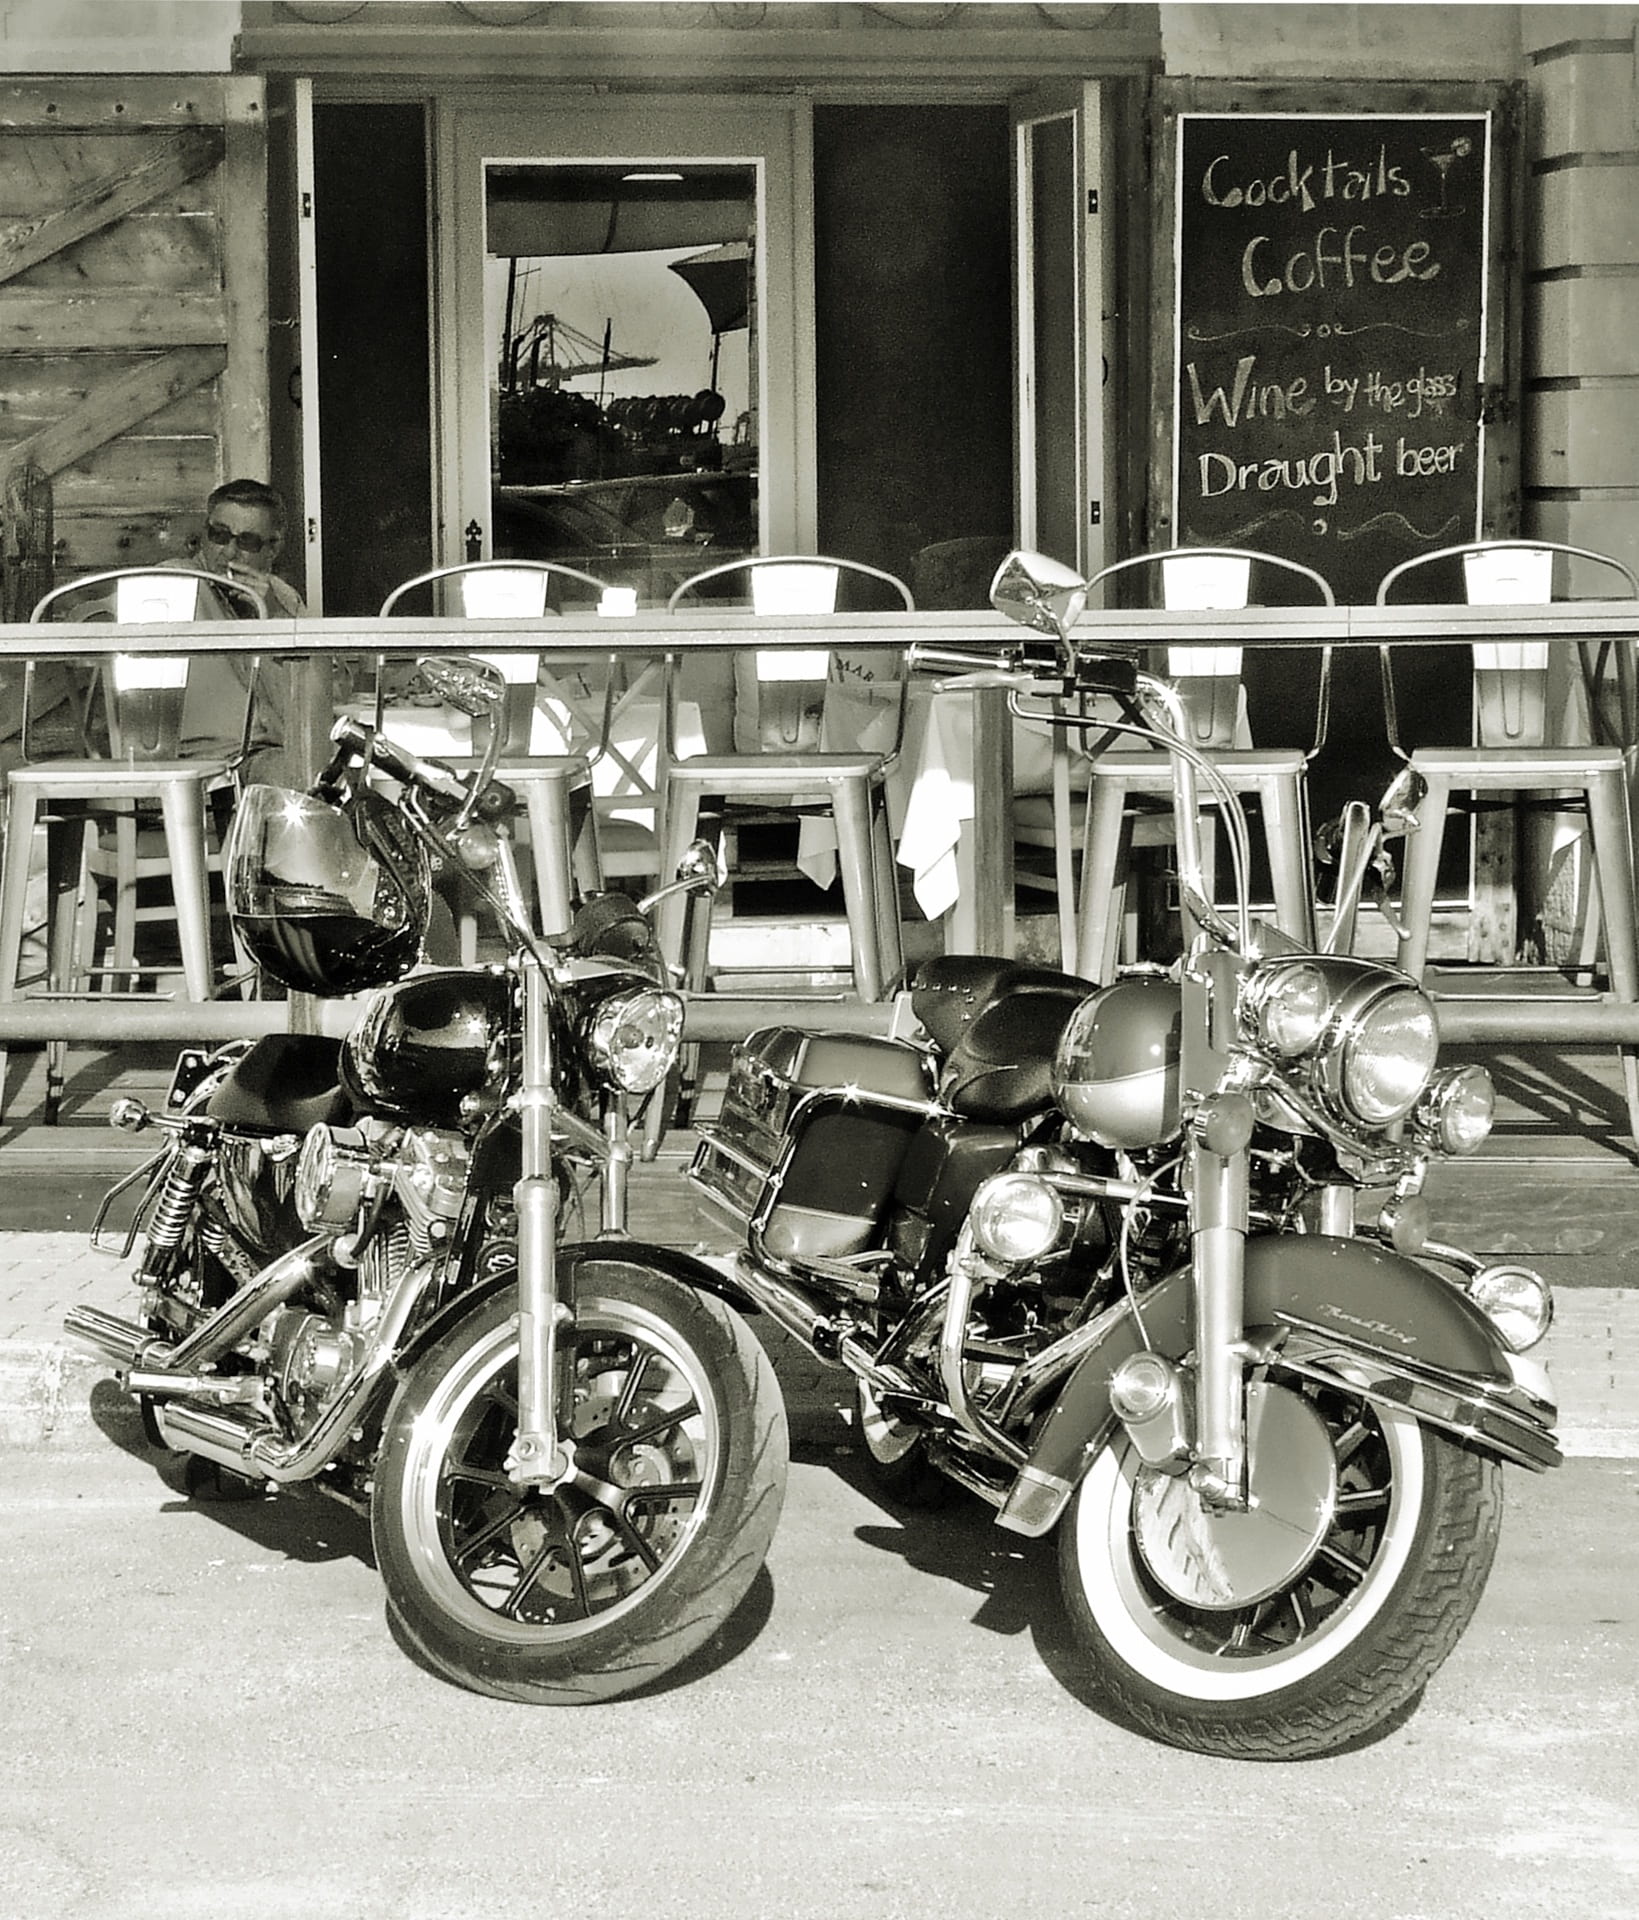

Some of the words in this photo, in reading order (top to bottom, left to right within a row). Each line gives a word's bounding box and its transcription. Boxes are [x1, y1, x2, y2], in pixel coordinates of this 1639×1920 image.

[1201, 144, 1411, 212] Cocktails
[1241, 225, 1442, 297] Coffee
[1187, 355, 1317, 428] Wine
[1324, 364, 1359, 412] by
[1363, 371, 1406, 412] the
[1406, 366, 1457, 418] glass
[1198, 430, 1384, 505] Draught
[1395, 437, 1465, 477] beer
